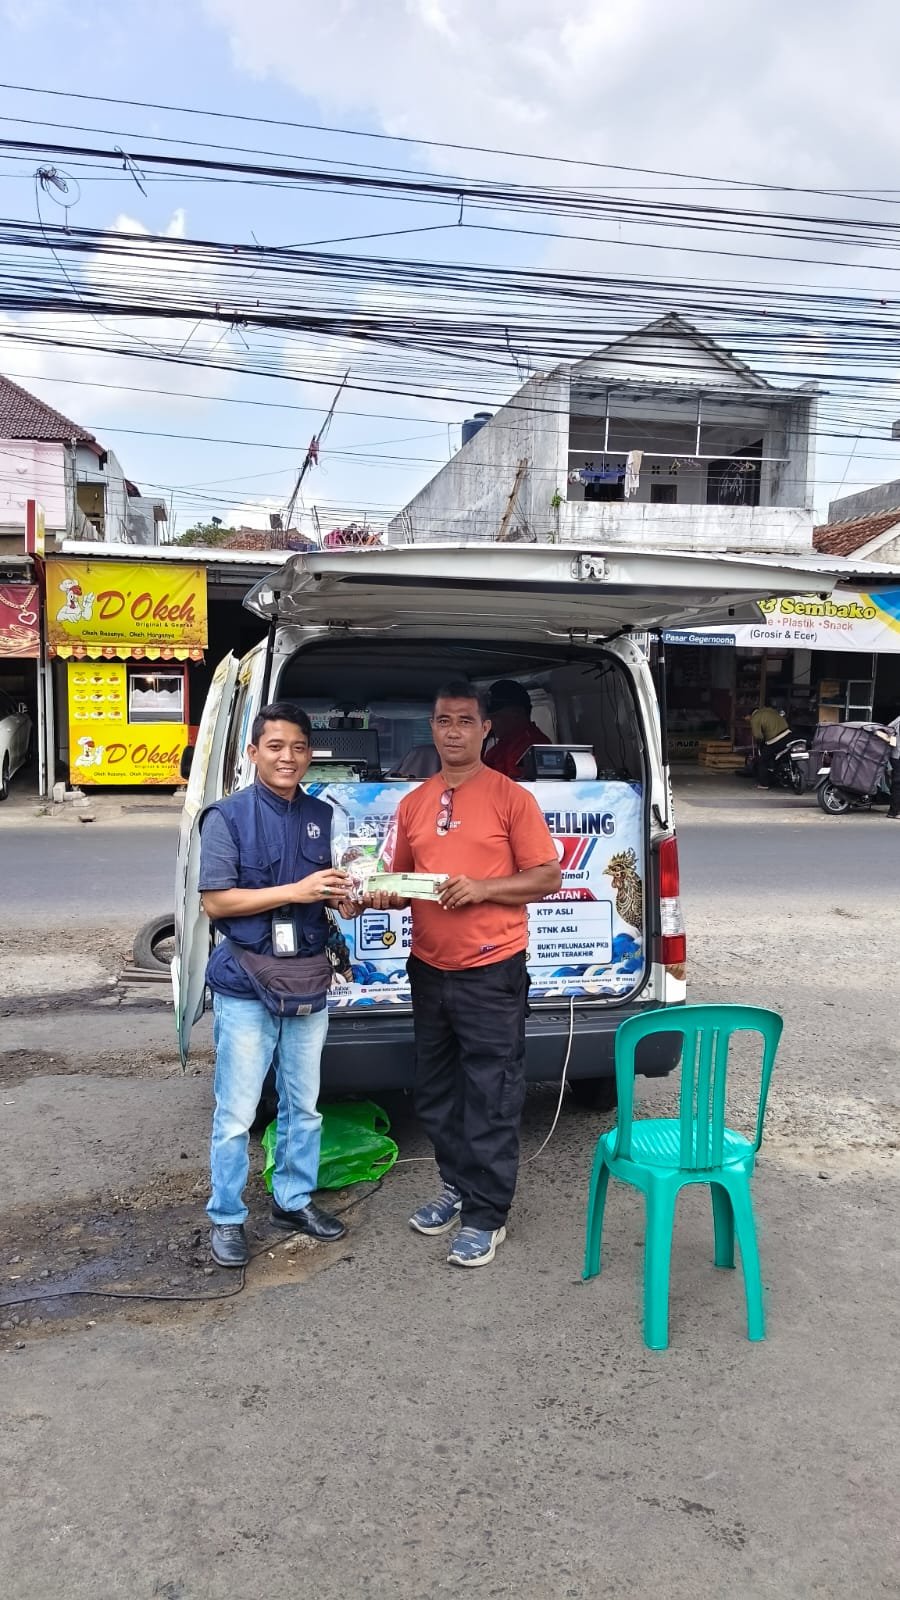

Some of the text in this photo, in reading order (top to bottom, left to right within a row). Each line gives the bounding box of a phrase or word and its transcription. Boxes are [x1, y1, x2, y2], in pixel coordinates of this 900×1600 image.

[97, 590, 196, 622] D'Okeh
[780, 598, 877, 619] Sembako
[782, 618, 815, 628] Plastik
[823, 620, 853, 630] Snack
[665, 633, 687, 641] Pasar
[750, 629, 818, 642] (Grosir & Ecer)
[105, 743, 180, 765] D'Okeh
[542, 812, 615, 835] ELILING
[561, 871, 584, 880] timal
[537, 907, 574, 916] KTP ASLI
[537, 925, 578, 934] STNK ASLI
[558, 942, 595, 950] PELUNASAN
